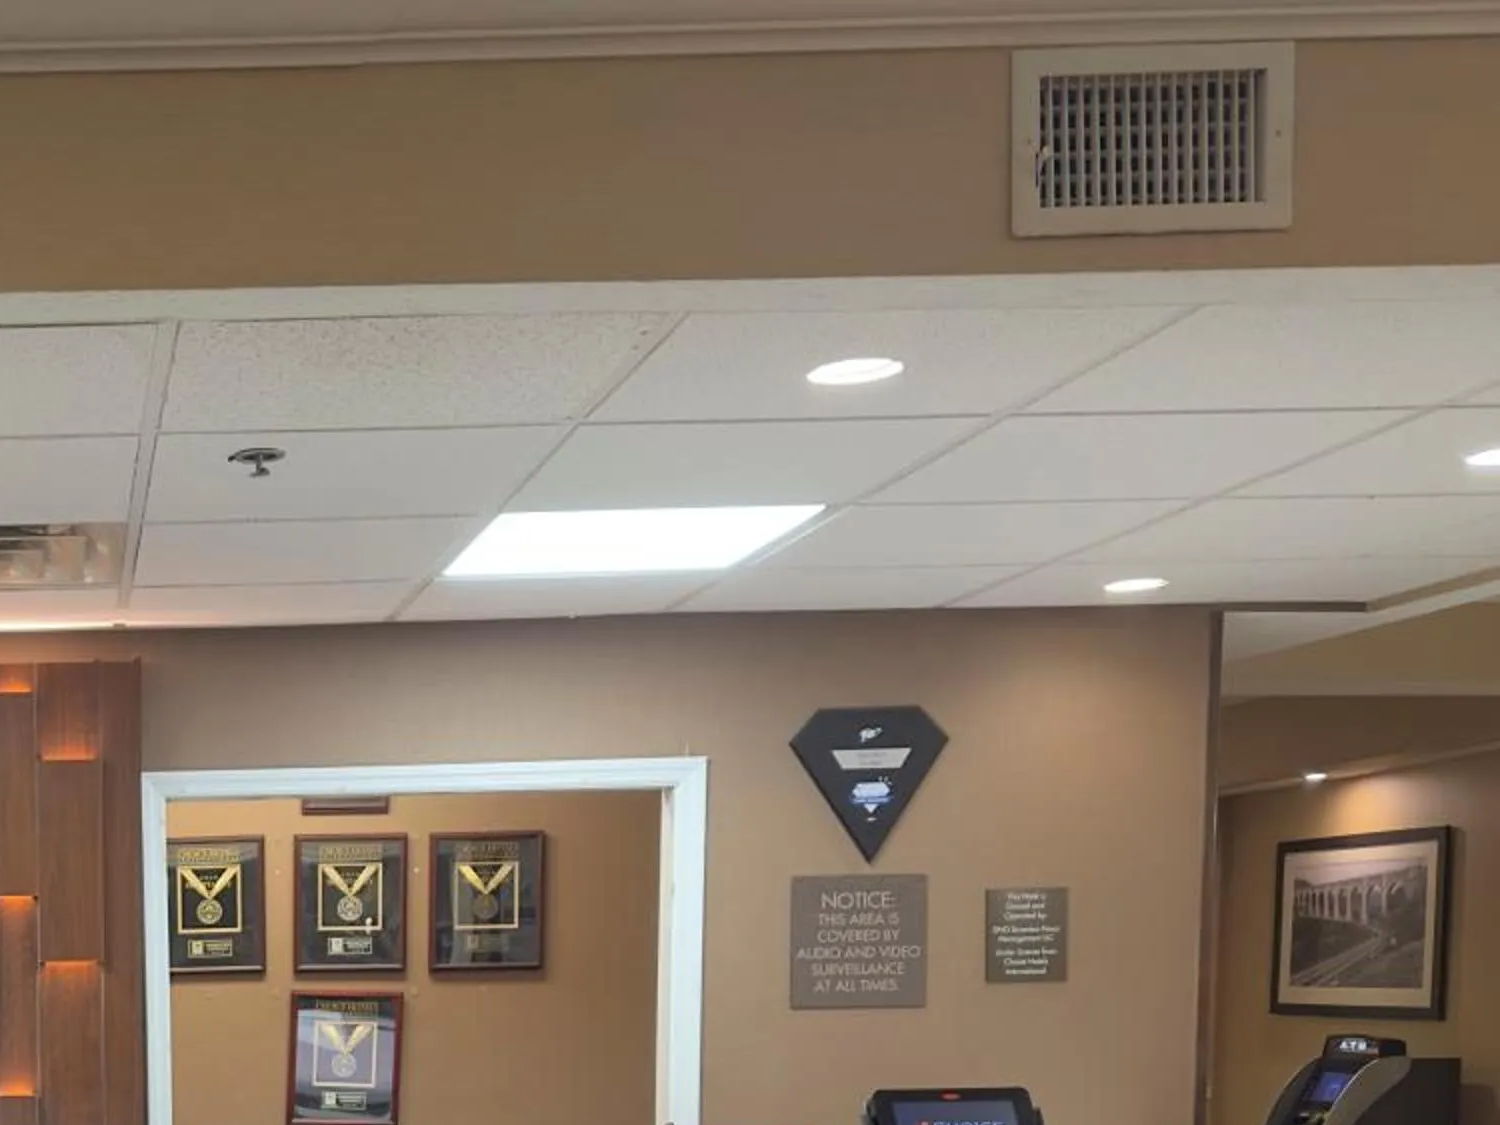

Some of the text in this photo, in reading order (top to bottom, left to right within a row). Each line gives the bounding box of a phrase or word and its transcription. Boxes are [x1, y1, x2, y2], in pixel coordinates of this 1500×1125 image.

[819, 911, 900, 926] THIS AREA IS
[817, 928, 900, 943] COVERED BY
[796, 945, 921, 959] AUDIO AND VIDEO
[813, 979, 831, 994] AT
[836, 979, 856, 992] ALL
[1340, 1041, 1367, 1051] ATM
